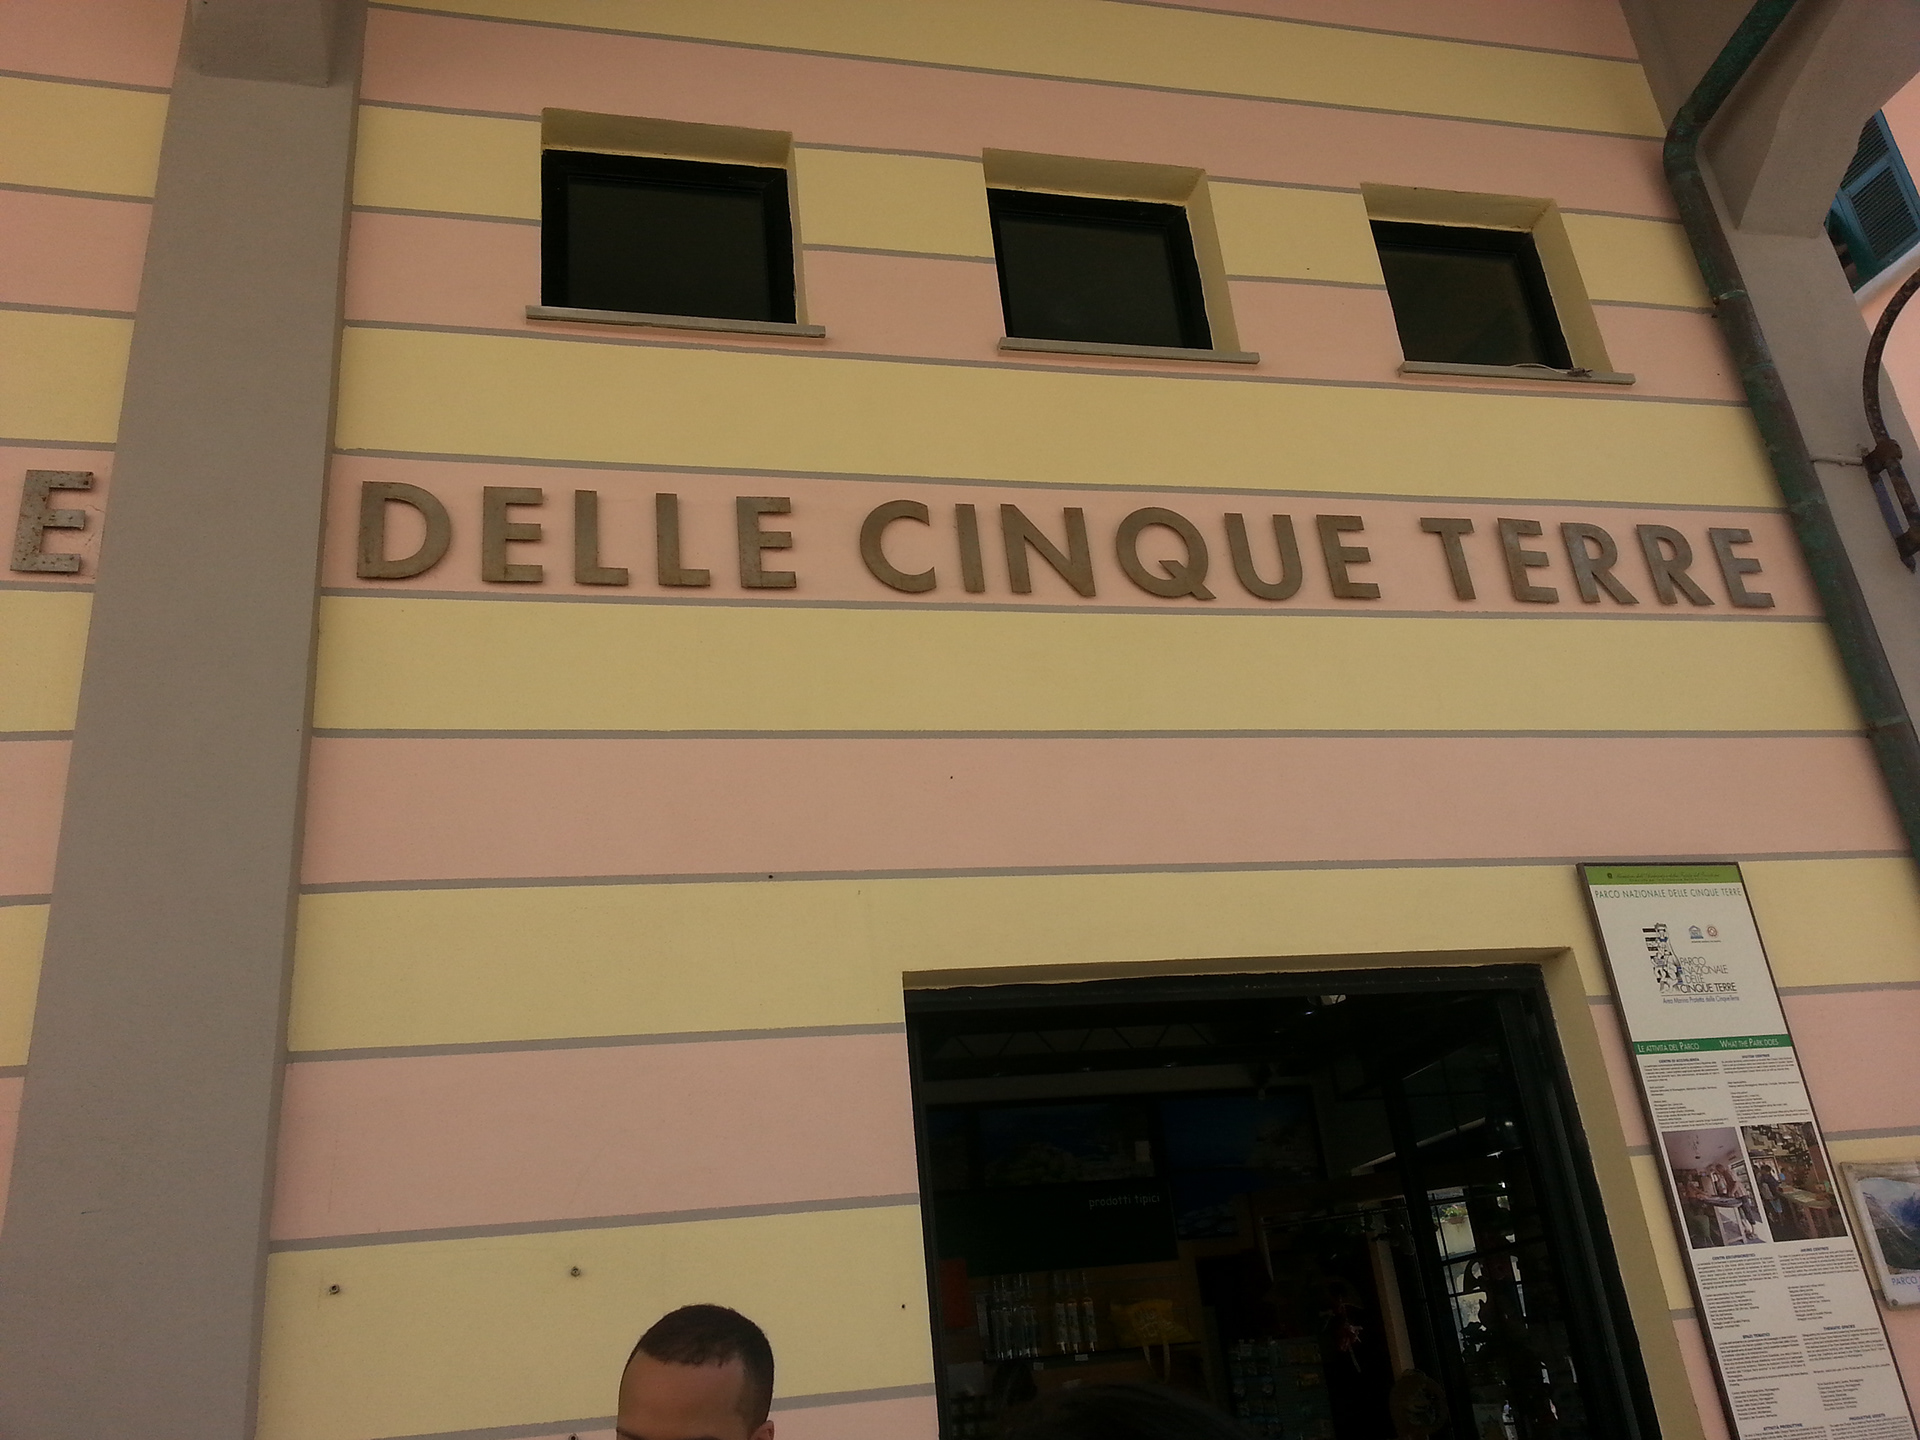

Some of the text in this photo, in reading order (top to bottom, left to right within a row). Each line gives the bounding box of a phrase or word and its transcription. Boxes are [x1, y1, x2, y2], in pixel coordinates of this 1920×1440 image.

[10, 469, 1776, 609] E DELLE CINQUE TERRE
[1594, 887, 1743, 899] PARCO NAZIONALE DELLE CINQUE TERRE
[1679, 956, 1706, 966] PARCO
[1682, 964, 1729, 975] NAZIONALE
[1684, 974, 1705, 984] DELLE
[1680, 982, 1737, 993] CINQUE TERRE
[1089, 1192, 1160, 1210] prodotti tipici
[1891, 1276, 1918, 1286] PARCO
